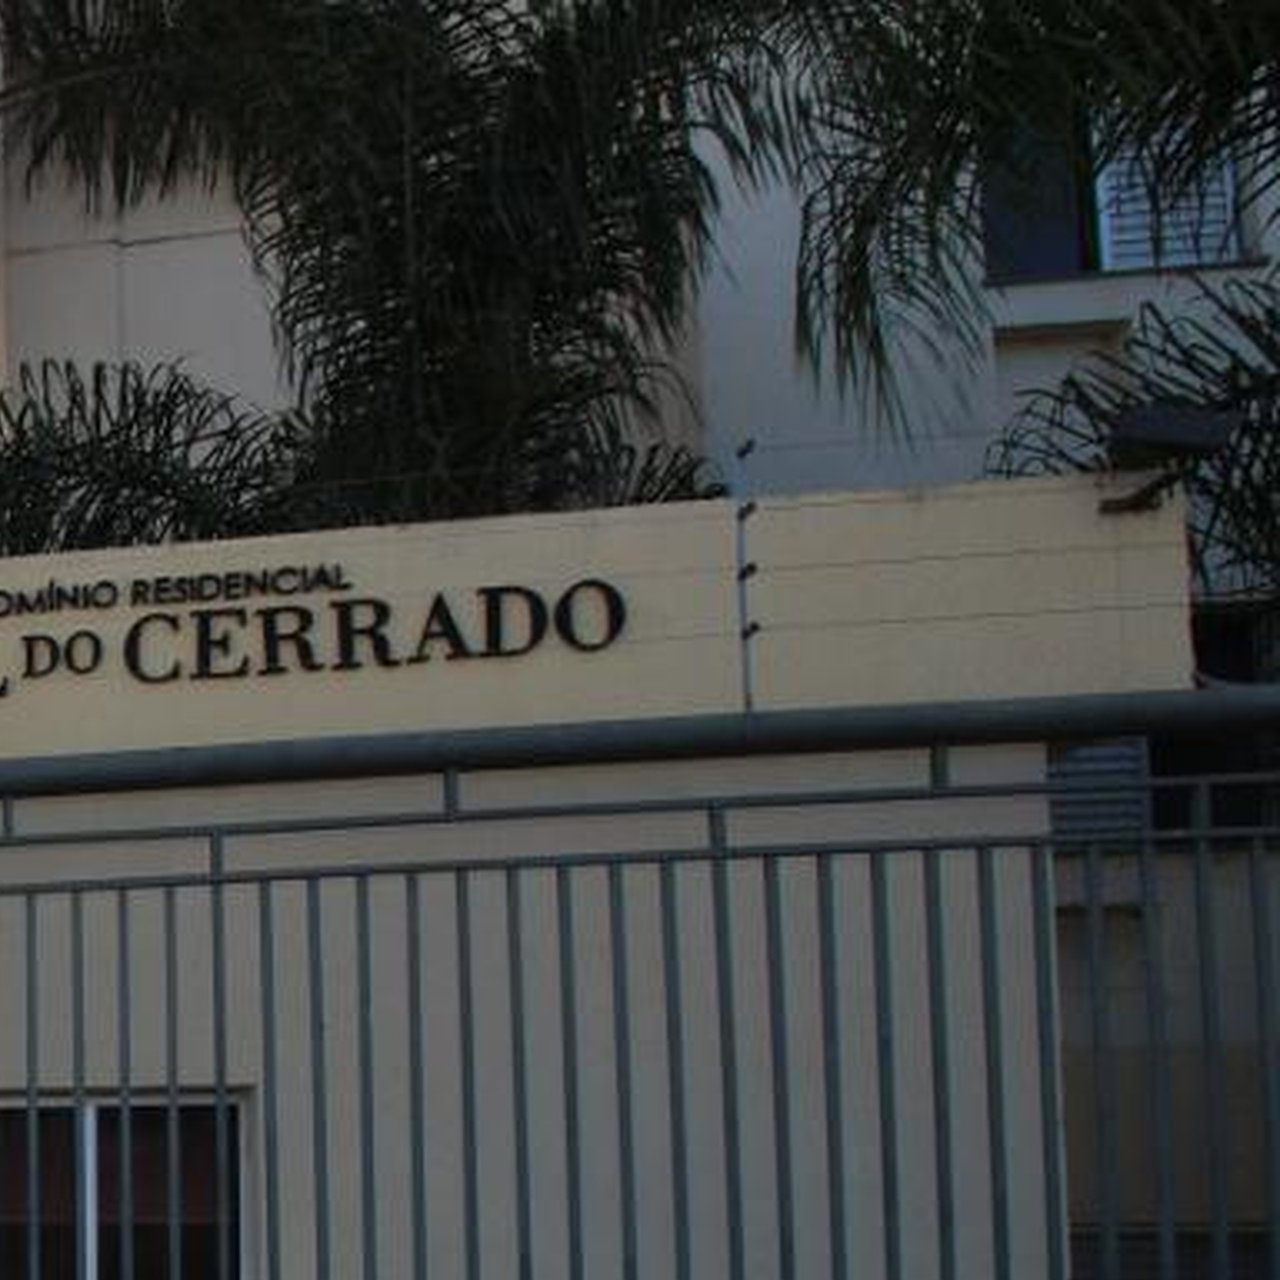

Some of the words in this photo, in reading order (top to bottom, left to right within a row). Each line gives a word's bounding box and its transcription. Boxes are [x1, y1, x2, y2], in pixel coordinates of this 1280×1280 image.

[130, 563, 353, 607] RESIDENCIAL
[21, 630, 102, 679] DO
[123, 578, 627, 684] CERRADO
